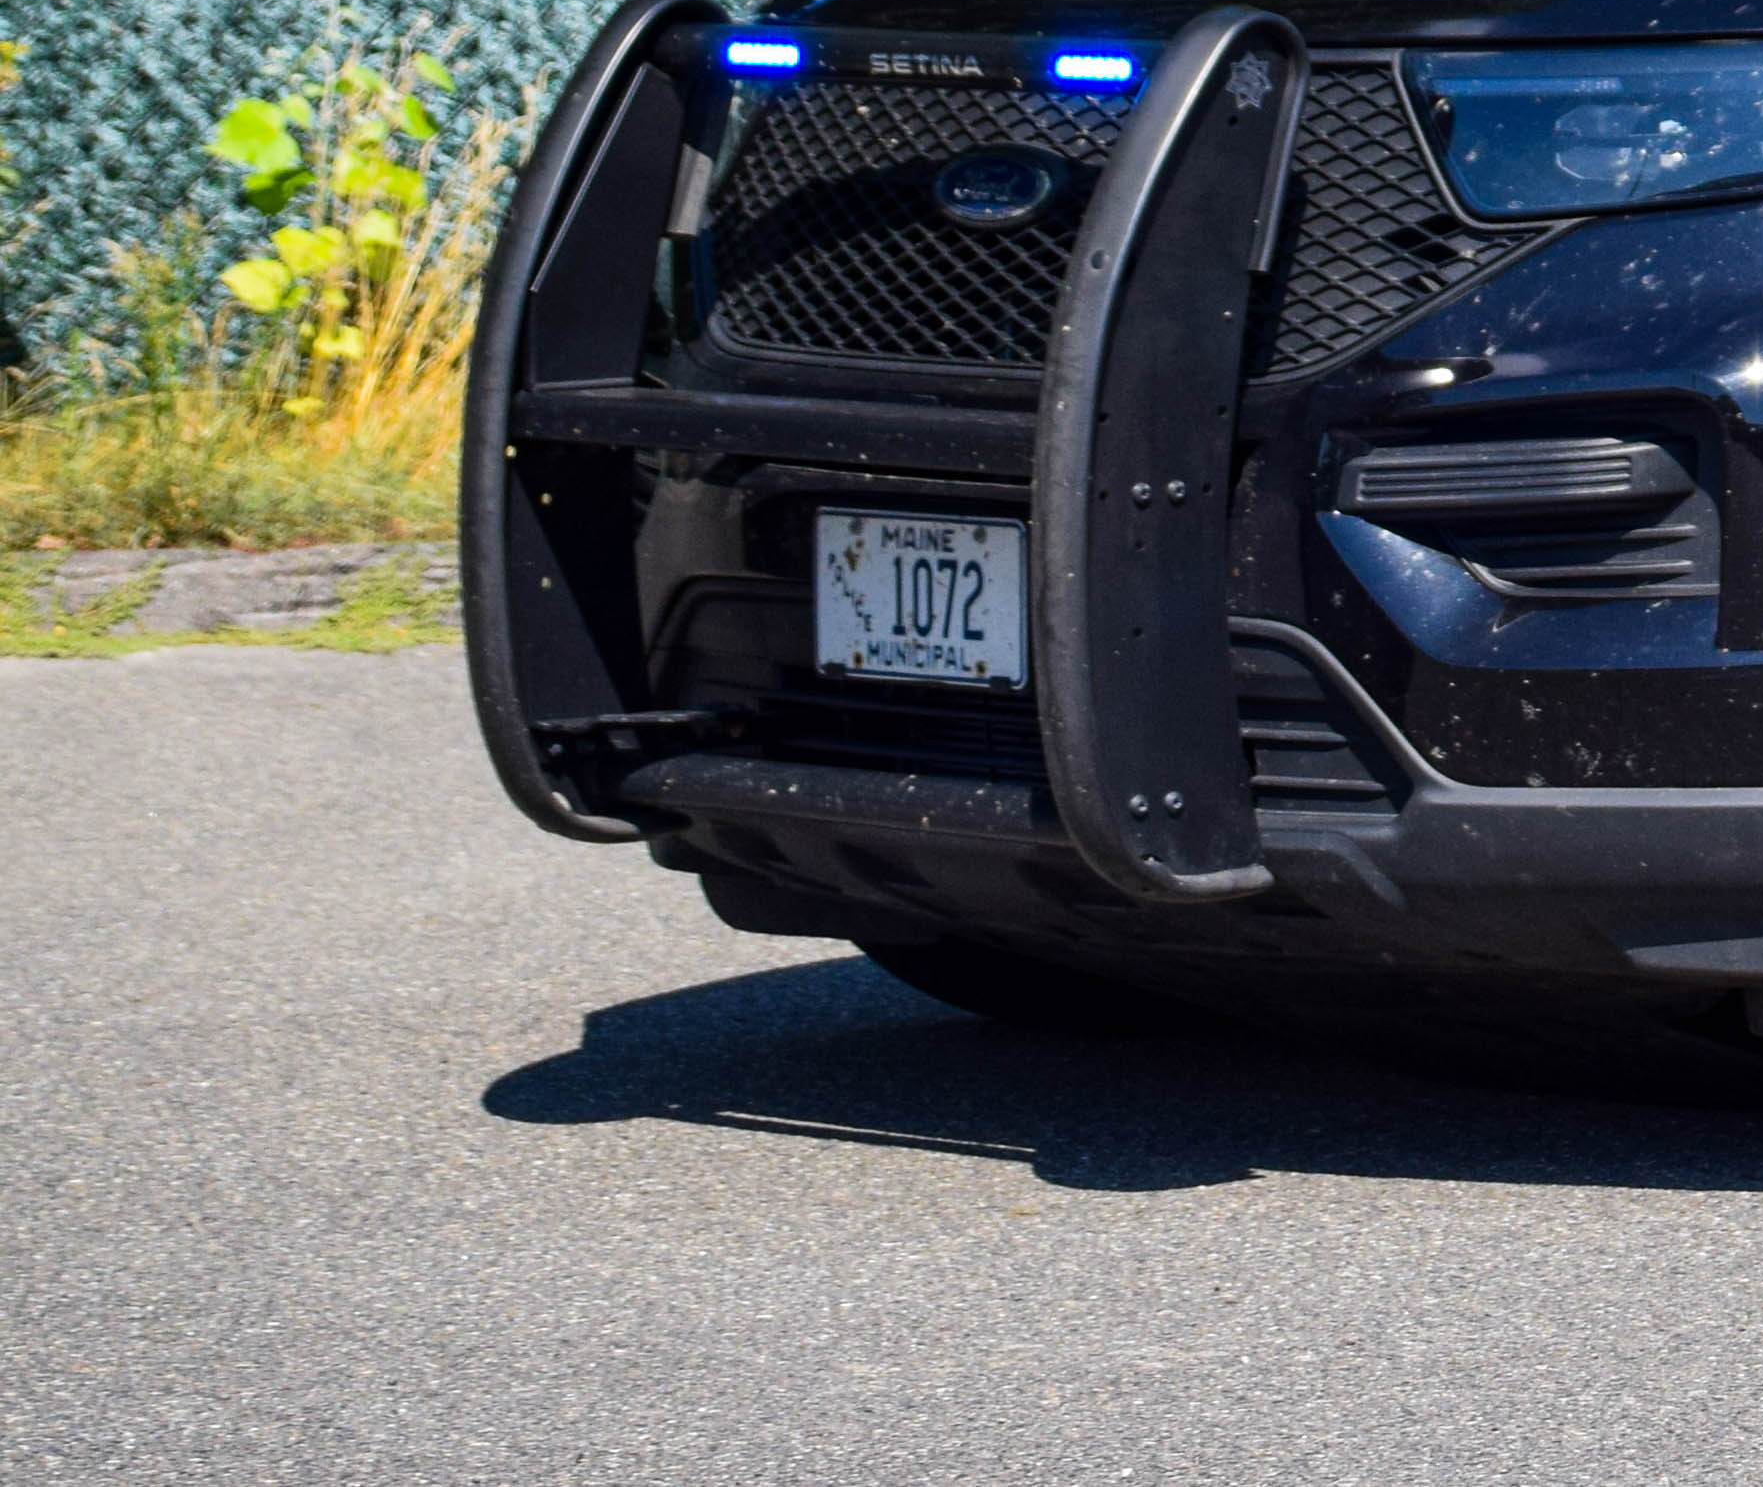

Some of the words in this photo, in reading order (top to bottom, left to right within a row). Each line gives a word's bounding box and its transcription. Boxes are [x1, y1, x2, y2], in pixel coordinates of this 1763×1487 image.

[869, 53, 985, 77] SETINA
[881, 525, 956, 553] MAINE
[892, 556, 984, 641] 1072
[866, 640, 972, 672] MUNICIPAL
